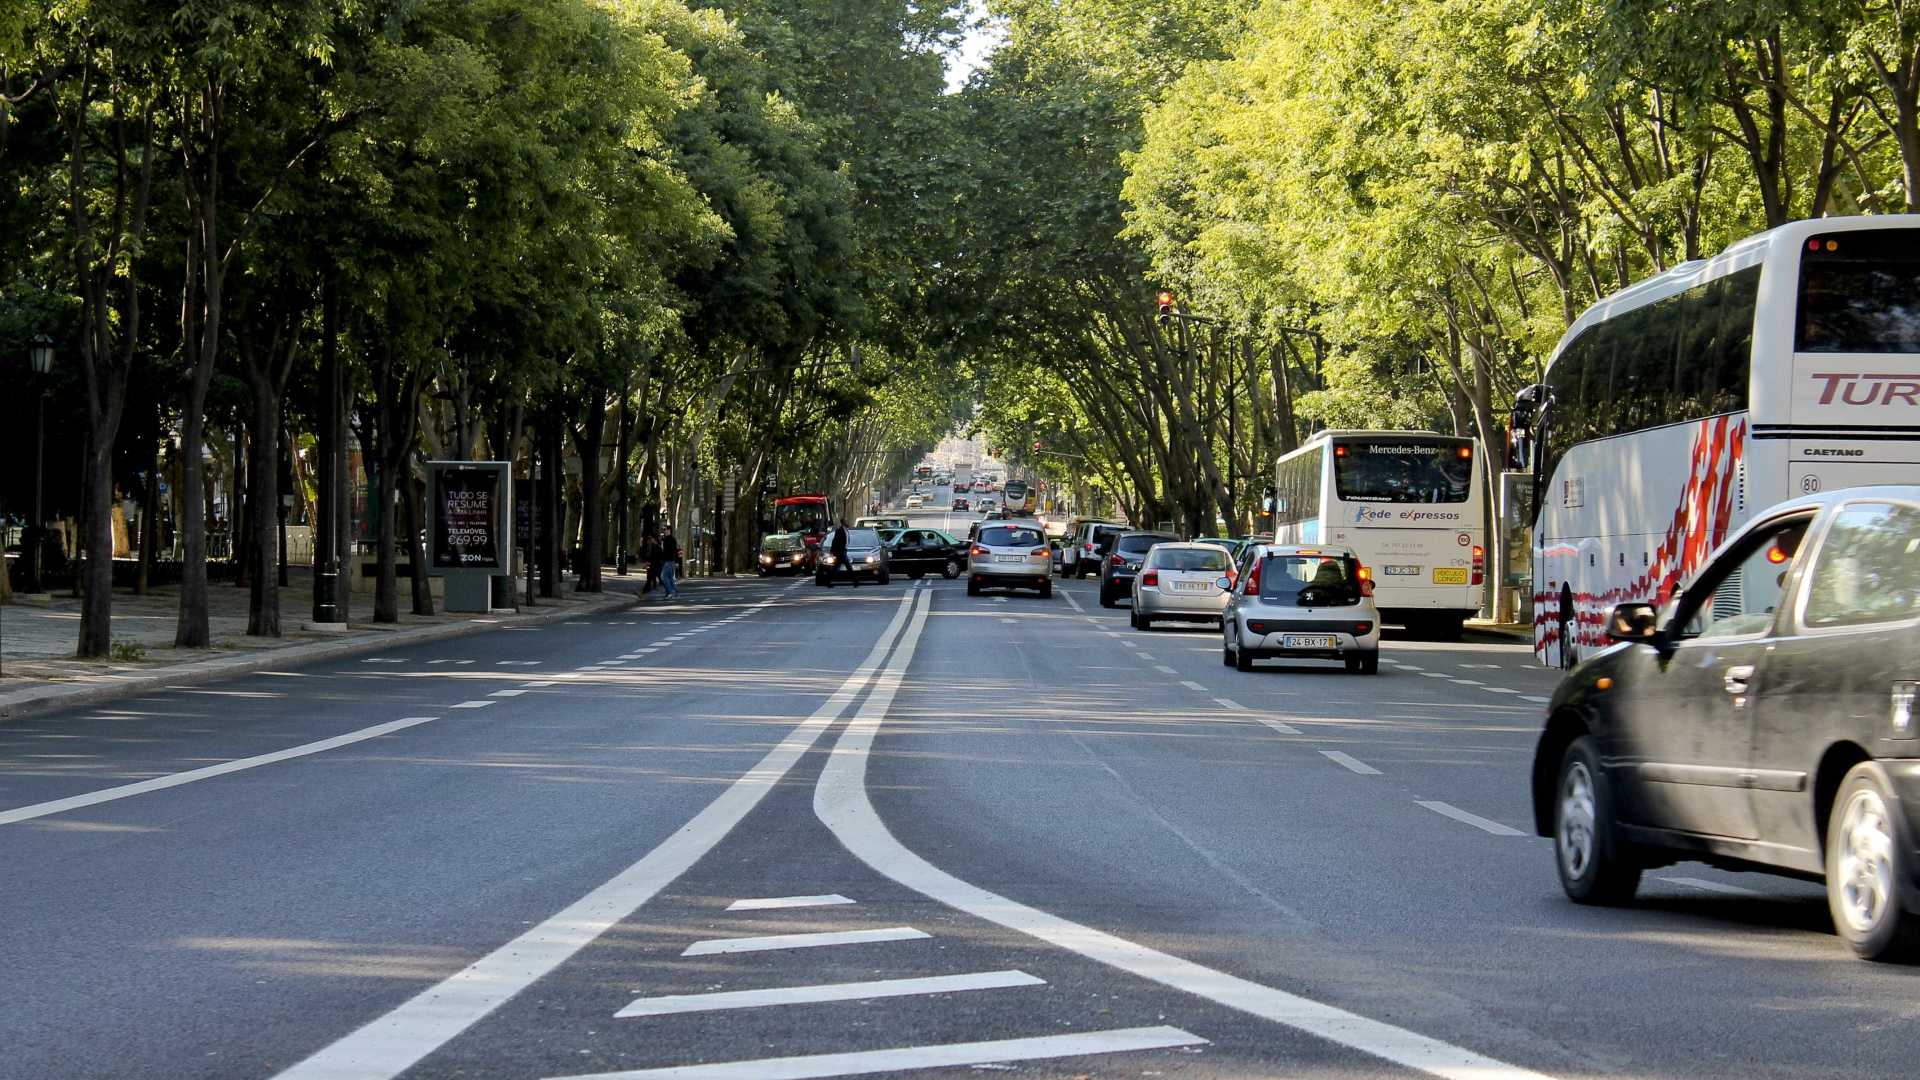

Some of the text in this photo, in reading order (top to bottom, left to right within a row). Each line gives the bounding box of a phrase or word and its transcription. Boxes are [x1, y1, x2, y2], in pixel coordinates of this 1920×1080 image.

[1369, 444, 1436, 455] Mercedes-Benz
[1803, 448, 1864, 457] CAETANO
[1803, 478, 1818, 492] 80
[448, 491, 488, 500] TUDO SE
[447, 500, 488, 509] RESUME
[1356, 506, 1392, 522] Rede
[448, 535, 488, 546] €69,99
[460, 554, 482, 562] ZON
